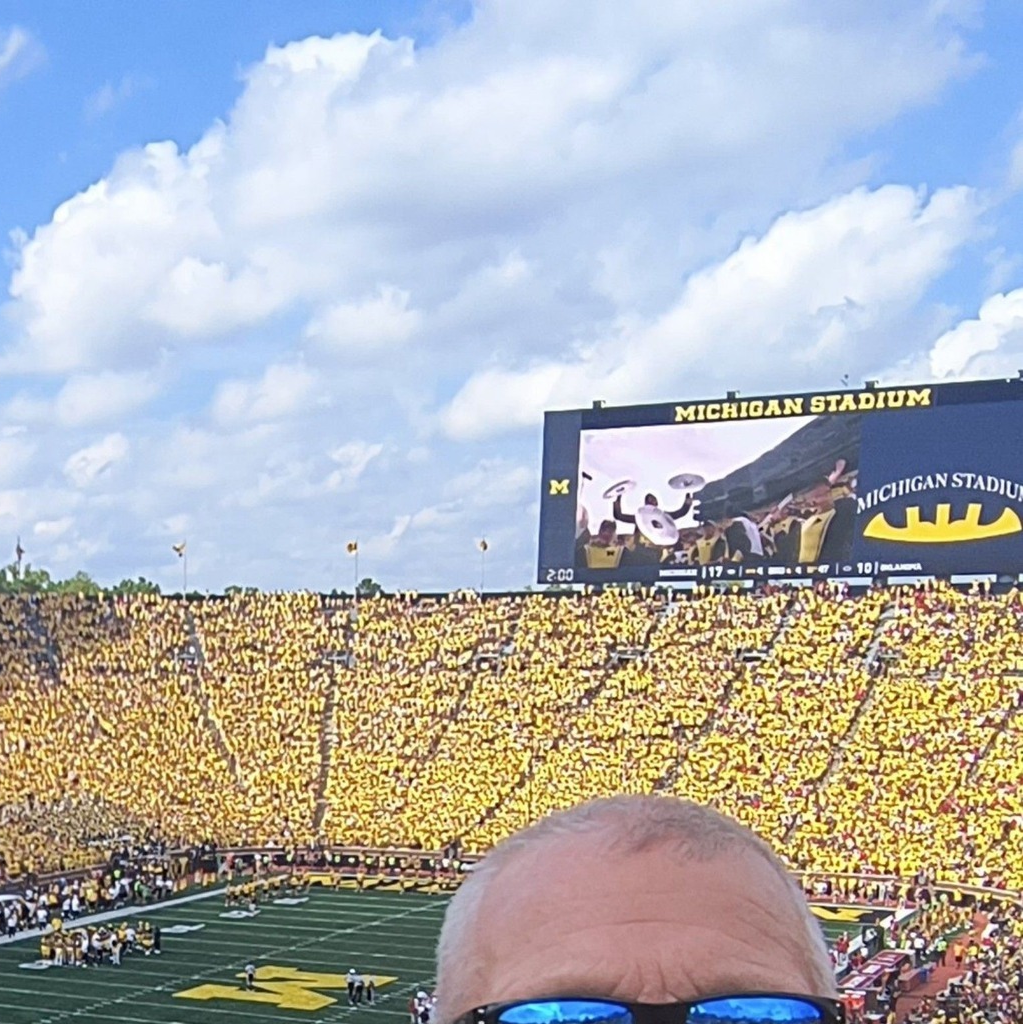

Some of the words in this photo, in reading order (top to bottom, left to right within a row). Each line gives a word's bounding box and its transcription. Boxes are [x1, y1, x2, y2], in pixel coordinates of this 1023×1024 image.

[674, 398, 803, 422] MICHIGAN
[810, 388, 932, 413] STADIUM
[549, 479, 570, 495] M
[856, 473, 948, 515] MICHIGAN
[708, 565, 724, 578] 17
[856, 562, 872, 574] 10
